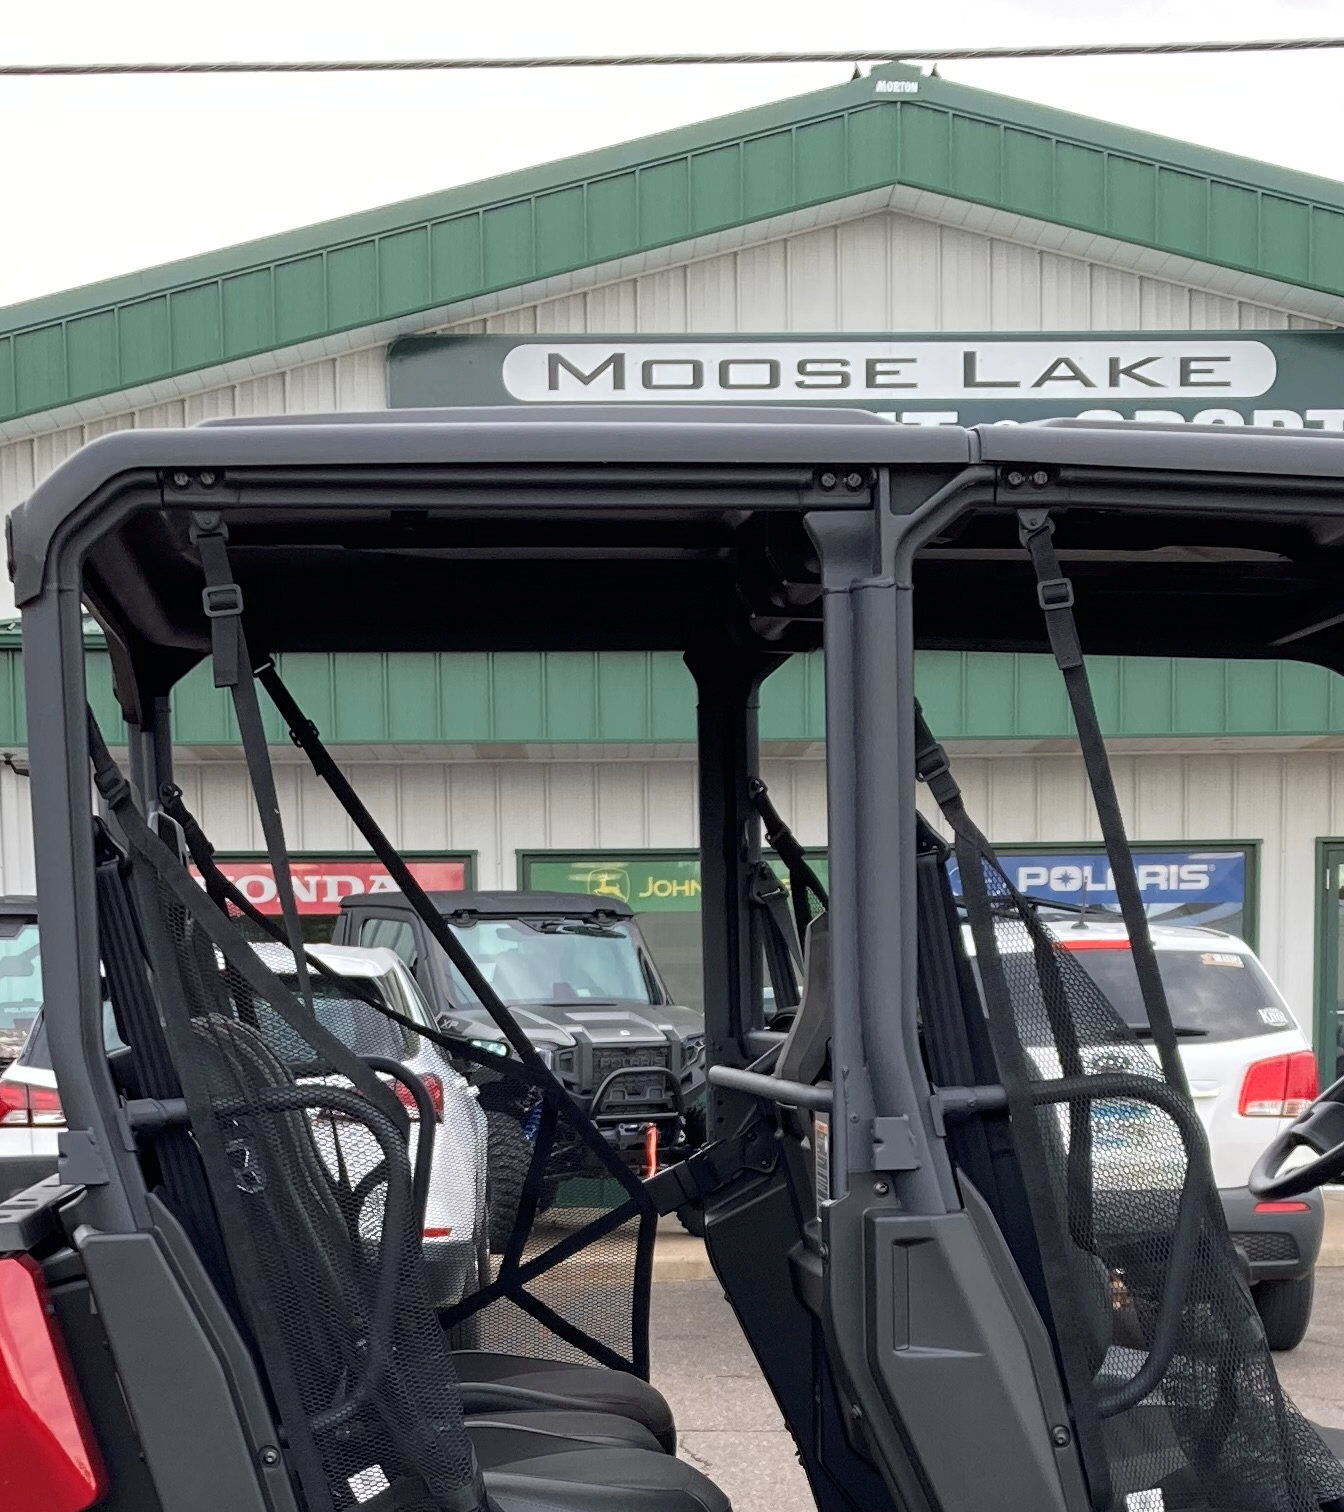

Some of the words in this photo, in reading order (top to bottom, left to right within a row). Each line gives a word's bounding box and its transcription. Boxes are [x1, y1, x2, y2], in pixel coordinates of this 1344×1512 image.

[875, 80, 918, 93] MORTON
[547, 352, 918, 391] MOOSE
[963, 351, 1232, 388] LAKE
[1017, 863, 1211, 894] POLRIS
[600, 1055, 666, 1068] POLARIS
